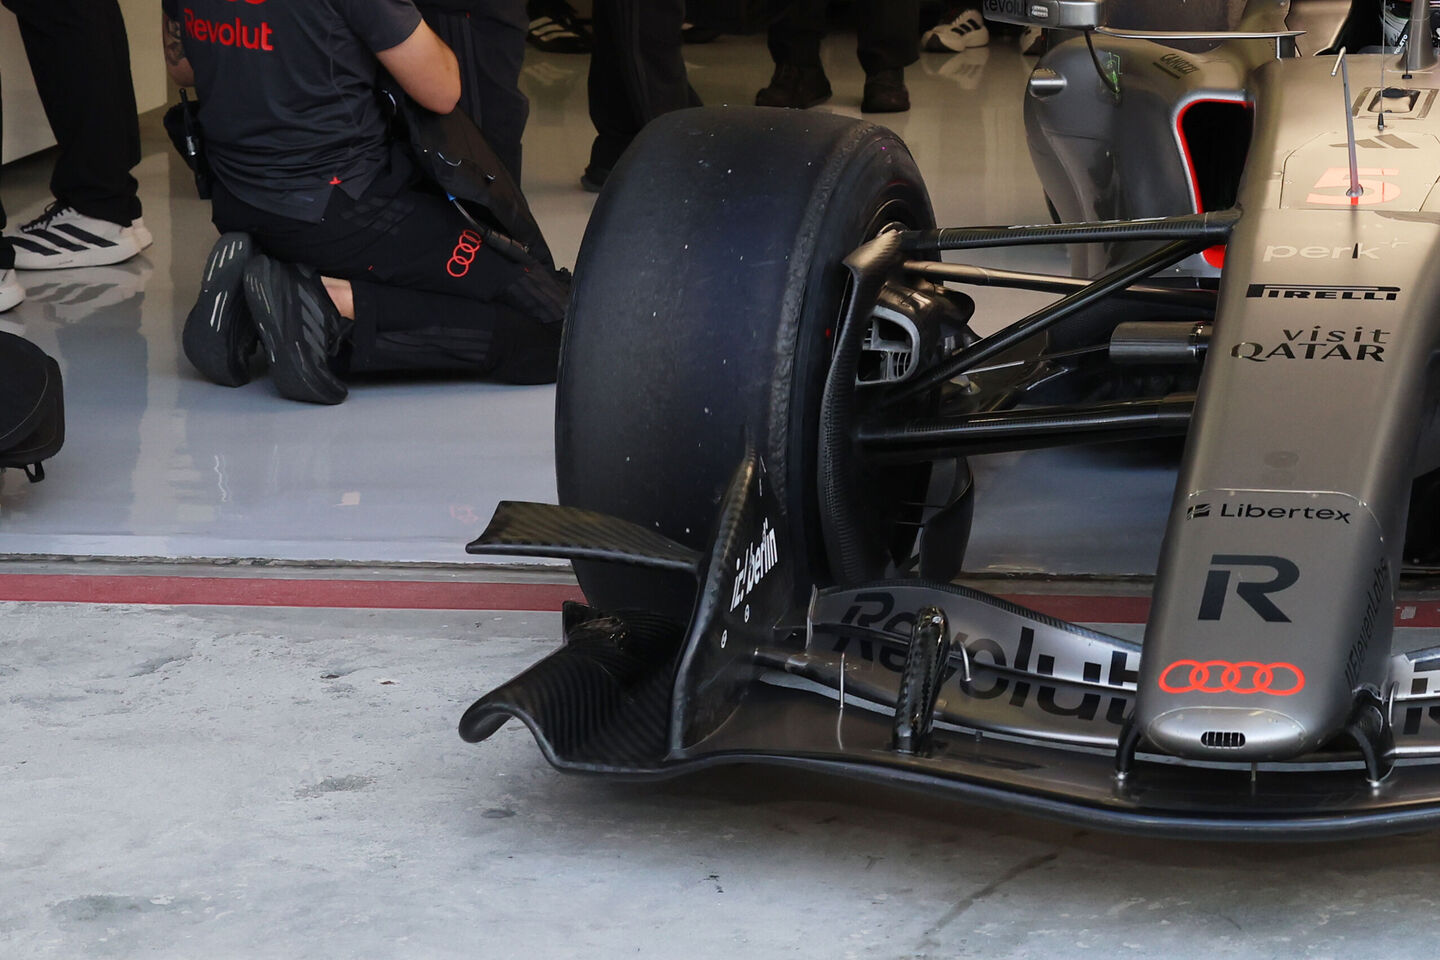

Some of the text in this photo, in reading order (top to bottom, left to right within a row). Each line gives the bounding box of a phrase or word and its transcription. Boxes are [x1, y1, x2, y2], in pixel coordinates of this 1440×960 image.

[184, 7, 275, 53] Revolut
[1306, 167, 1402, 206] 5
[1262, 242, 1380, 262] perk
[1245, 283, 1401, 301] PIRELLI
[1282, 326, 1392, 343] visit
[1230, 341, 1386, 363] QATAR
[1220, 503, 1352, 524] Libertex
[1197, 553, 1301, 623] R
